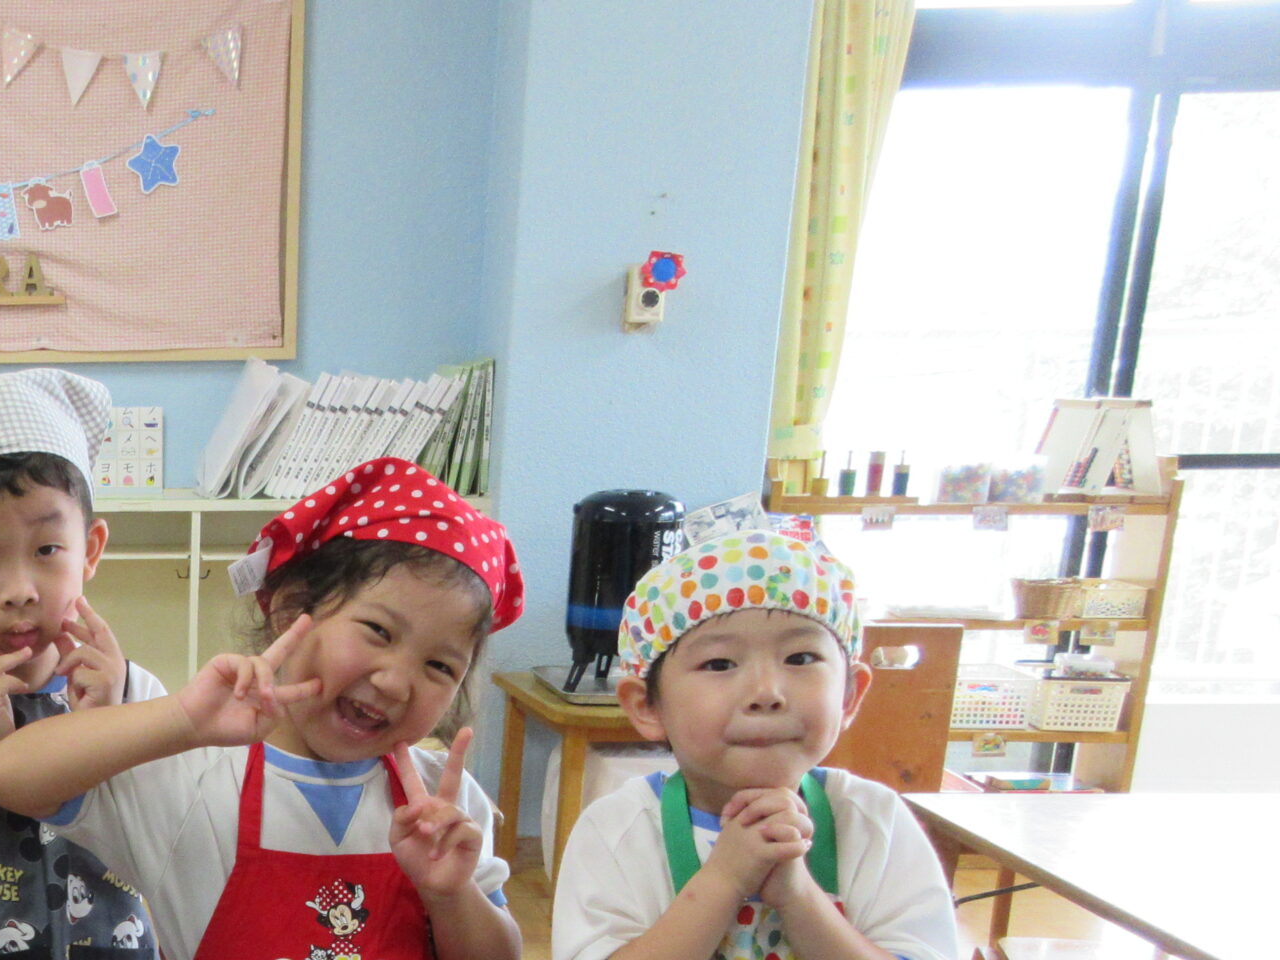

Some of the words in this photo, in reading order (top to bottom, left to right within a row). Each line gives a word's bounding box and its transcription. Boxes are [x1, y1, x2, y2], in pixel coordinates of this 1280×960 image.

[101, 463, 111, 473] ヨ
[123, 463, 134, 473] モ
[146, 462, 158, 474] ホ
